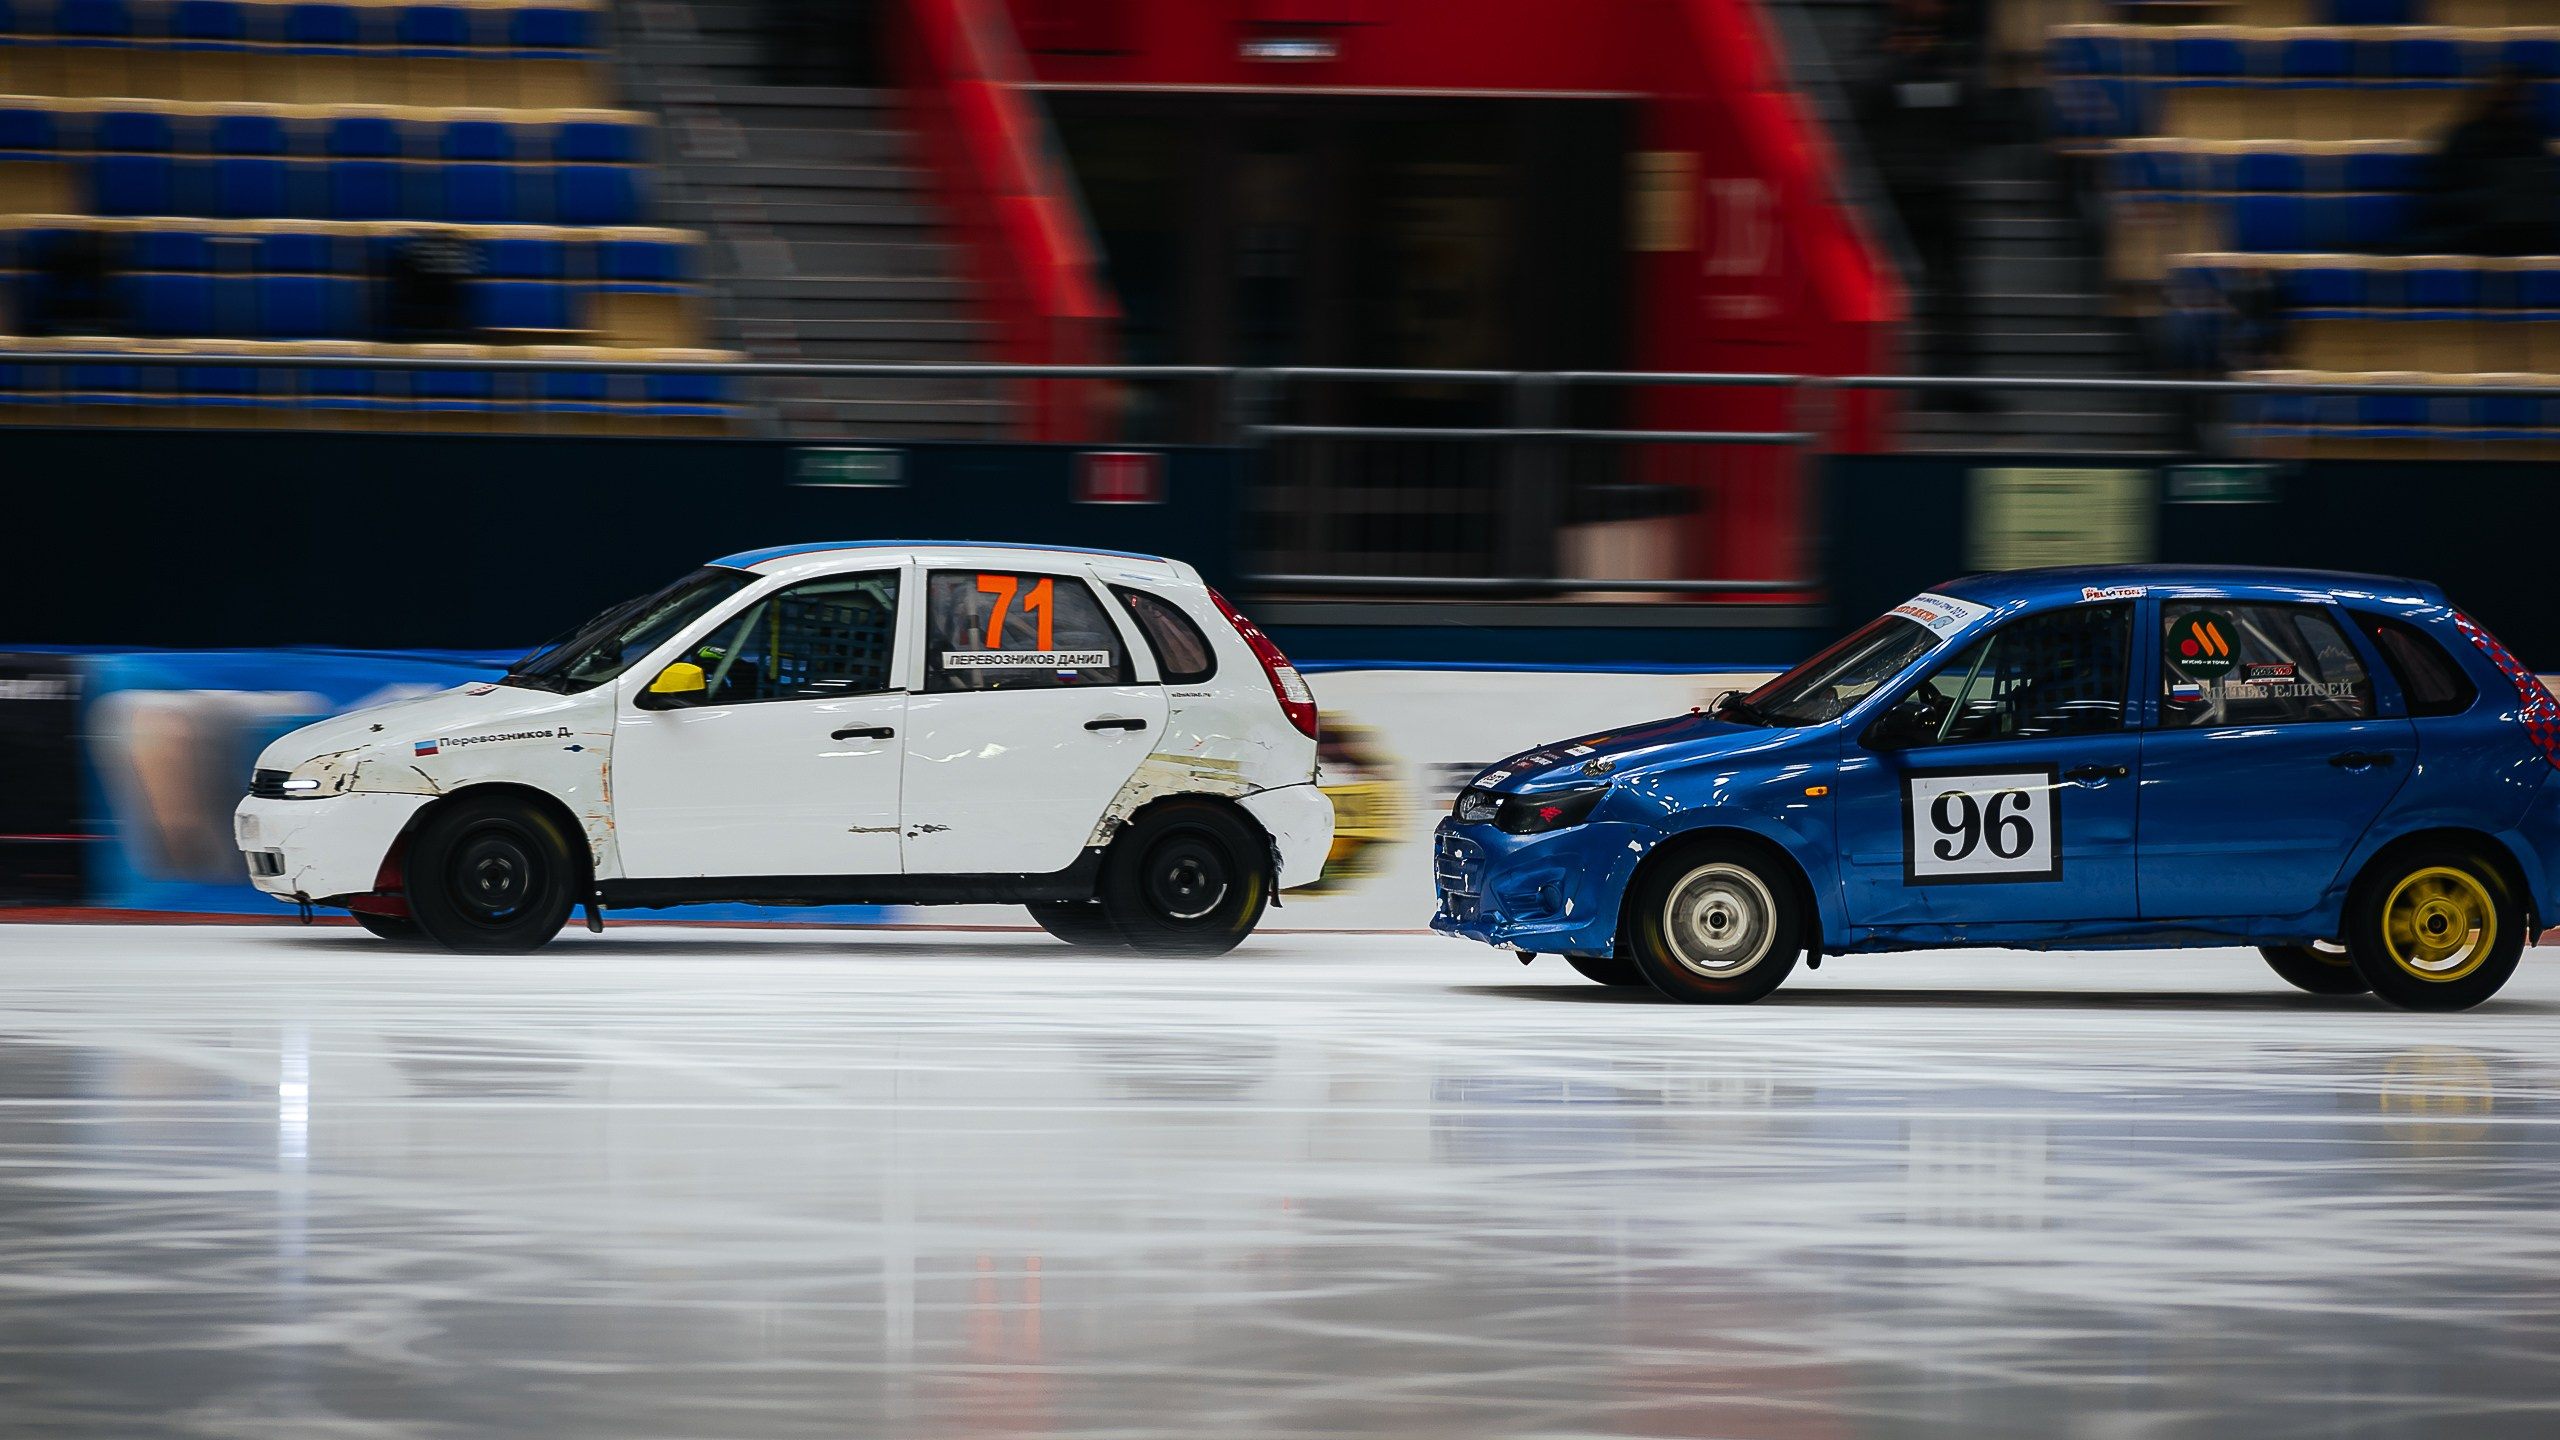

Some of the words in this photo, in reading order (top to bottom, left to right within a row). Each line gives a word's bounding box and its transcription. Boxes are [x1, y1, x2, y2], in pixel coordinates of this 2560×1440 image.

[976, 574, 1053, 651] 71
[950, 654, 1055, 666] ПЕРЕВОЗНИКОВ
[1057, 653, 1103, 666] ДАНИЛ
[2274, 679, 2352, 698] ЕЛИСЕЙ
[439, 730, 553, 747] Перевозников
[557, 726, 574, 738] Д.
[1930, 788, 2034, 861] 96
